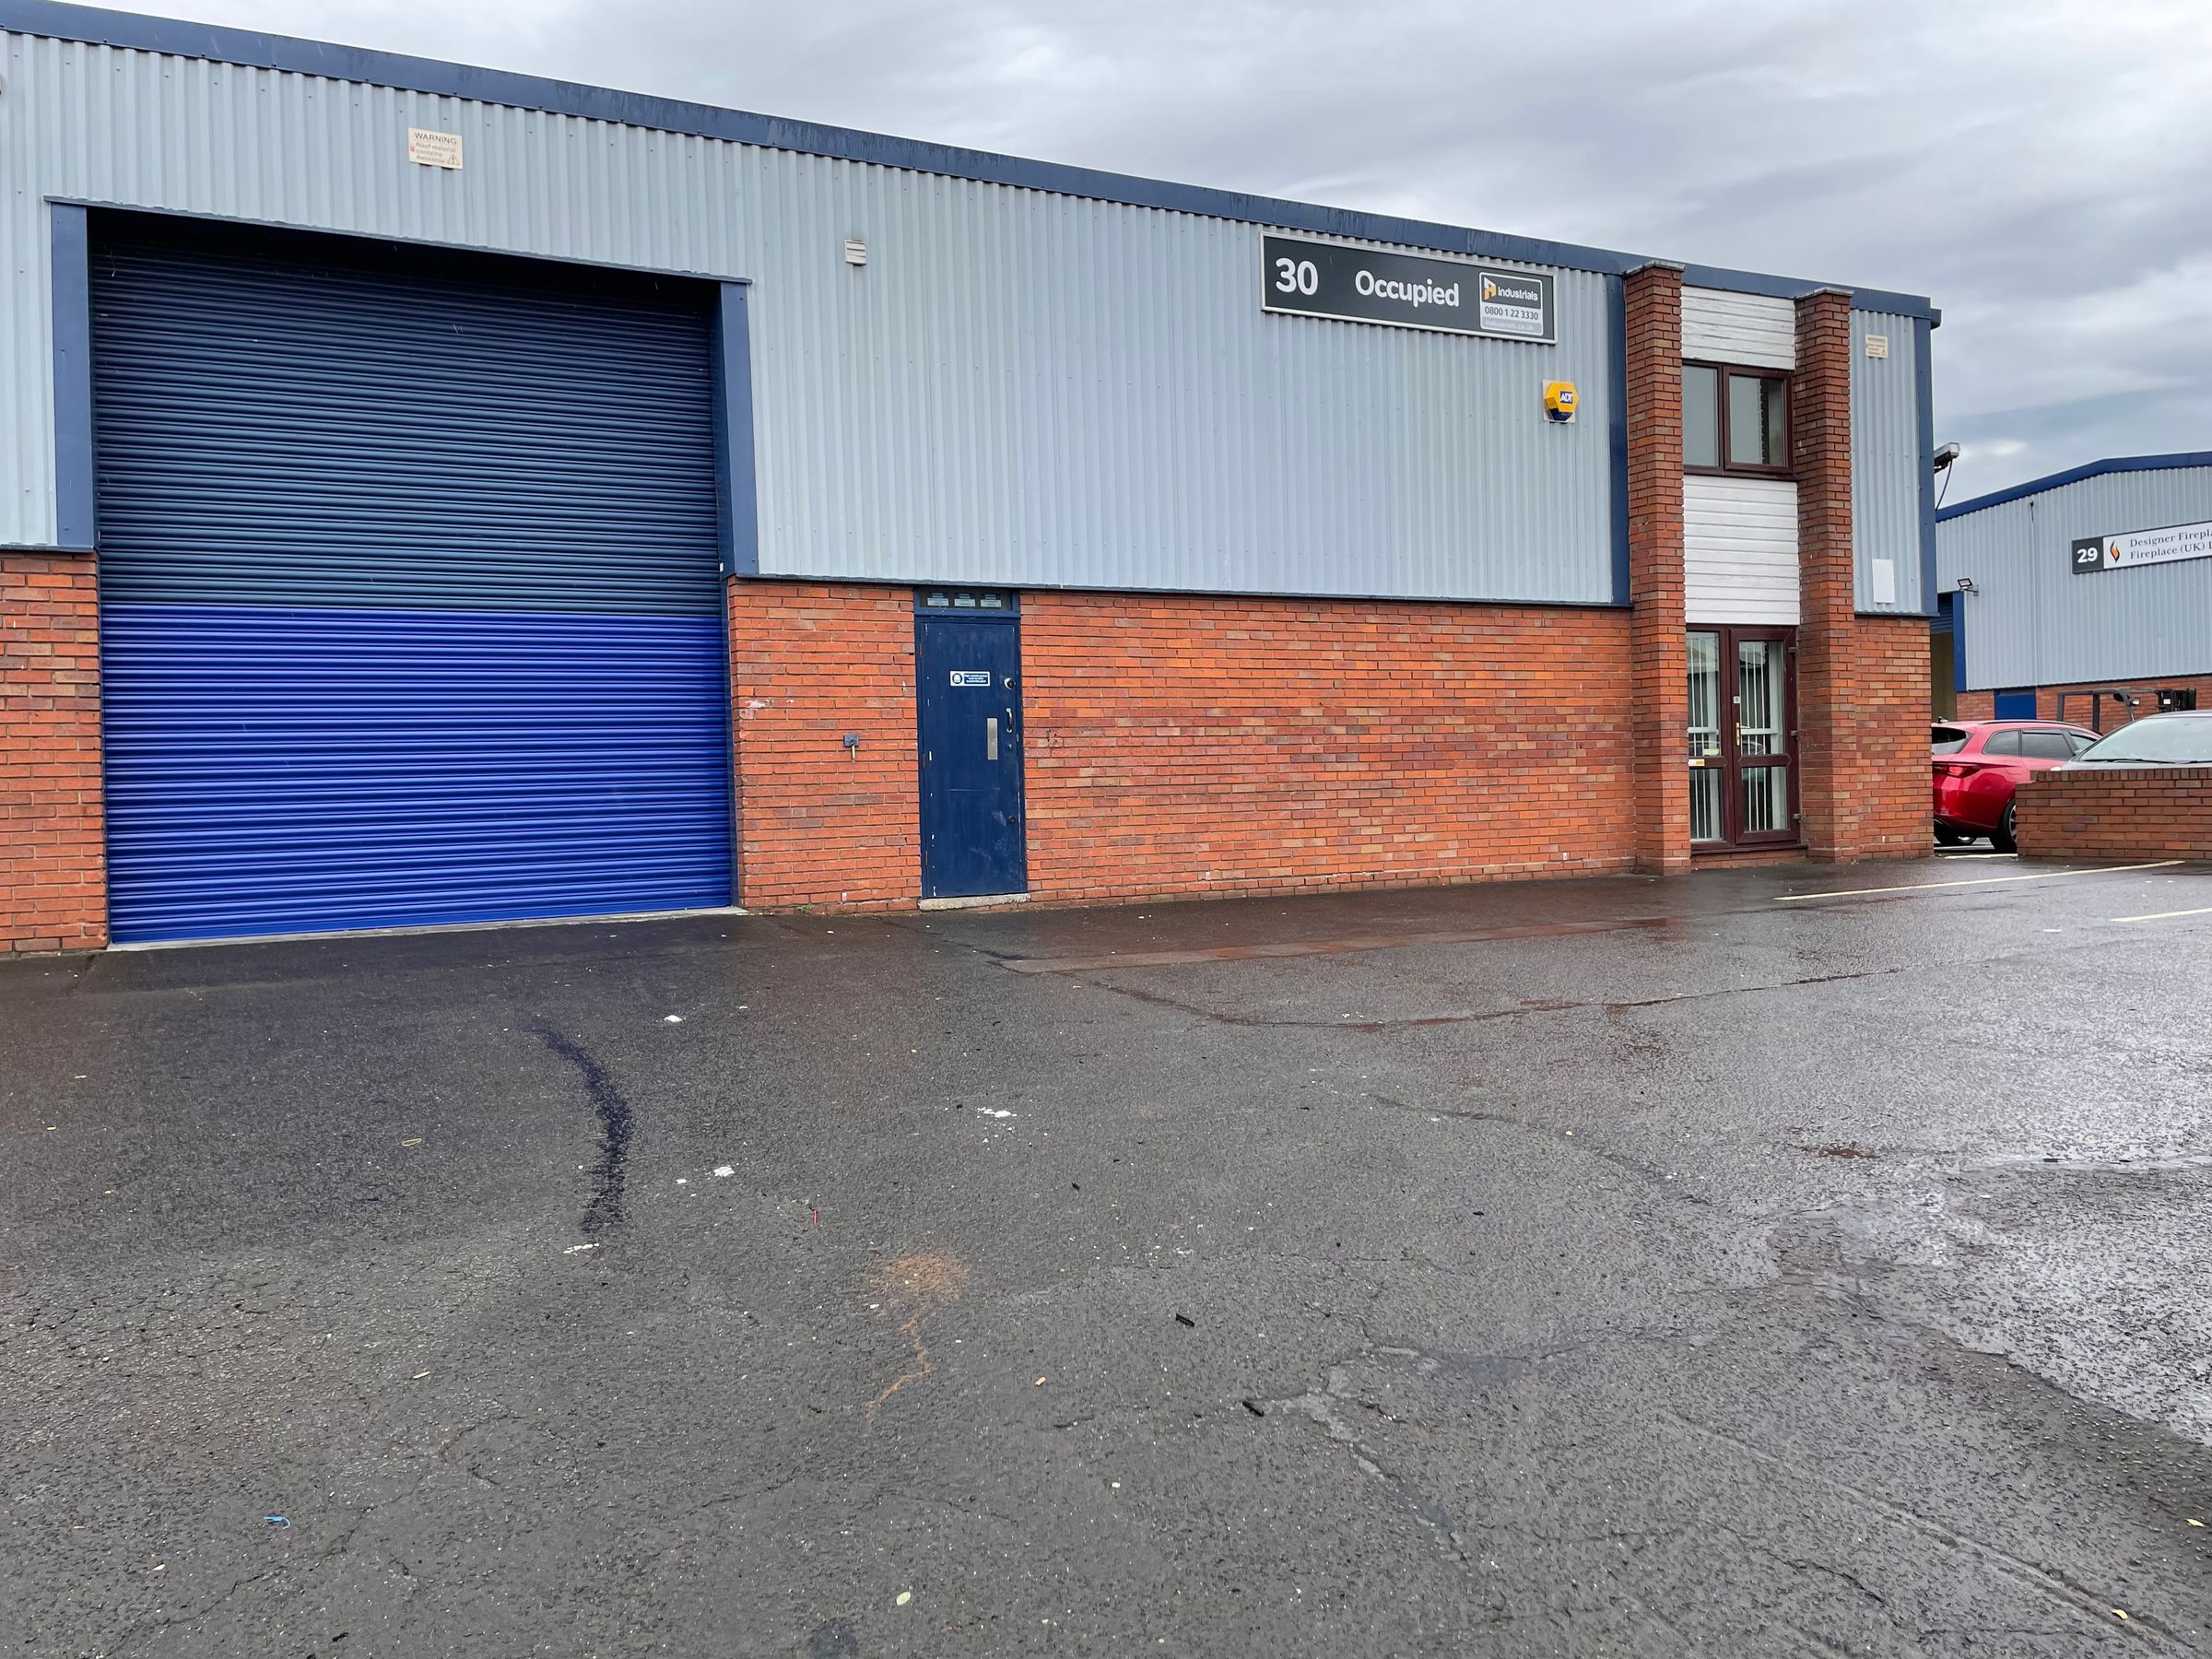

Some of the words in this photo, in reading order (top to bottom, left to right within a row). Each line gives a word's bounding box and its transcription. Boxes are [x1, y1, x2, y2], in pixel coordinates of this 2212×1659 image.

[414, 132, 457, 145] WARNING
[1276, 257, 1319, 296] 30
[1355, 269, 1460, 308] Occupied
[1484, 306, 1503, 316] 0800
[1510, 309, 1520, 318] 22
[1521, 310, 1539, 321] 3330
[1560, 392, 1573, 403] ADT
[2130, 535, 2176, 547] Designer
[2178, 528, 2212, 541] Firepl
[2077, 547, 2099, 563] 29
[2130, 547, 2178, 559] Fireplace
[2180, 542, 2206, 554] (UK)
